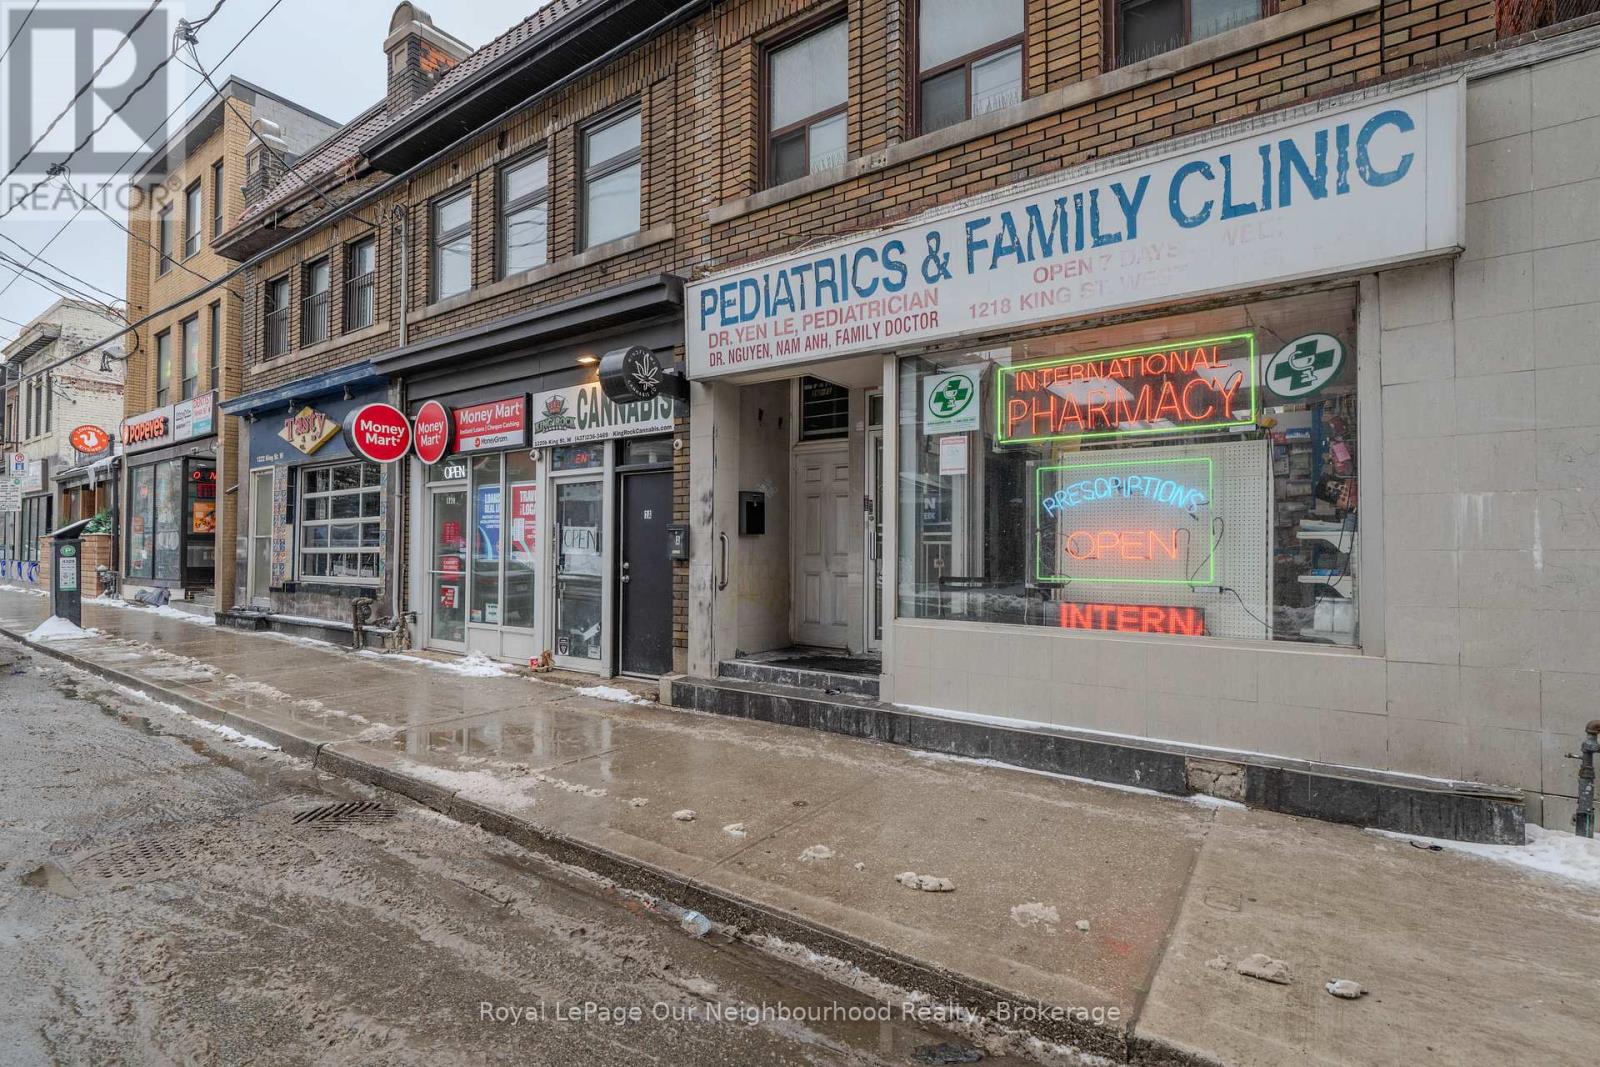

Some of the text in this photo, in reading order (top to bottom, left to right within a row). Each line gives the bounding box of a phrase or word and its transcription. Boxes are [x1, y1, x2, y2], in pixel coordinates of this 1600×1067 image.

[701, 110, 1415, 332] PEDIATRICS & FAMILY CLINIC
[1033, 256, 1093, 284] OPEN
[969, 299, 1011, 320] 1218
[1020, 286, 1071, 312] KING
[709, 288, 939, 349] DR. YEN LE, PEDIATRICIAN
[709, 311, 939, 367] DR. NGUYEN, NAM ANH, FAMILY DOCTOR
[1016, 346, 1228, 392] INTERNATIONAL
[460, 402, 521, 425] Money Mart
[1008, 370, 1243, 437] PHARMACY
[360, 419, 405, 438] Money
[365, 432, 399, 447] Mart
[418, 421, 444, 435] Money
[421, 434, 440, 447] Mart
[444, 465, 466, 479] OPEN
[564, 529, 596, 549] OPEN
[1067, 528, 1179, 560] OPEN
